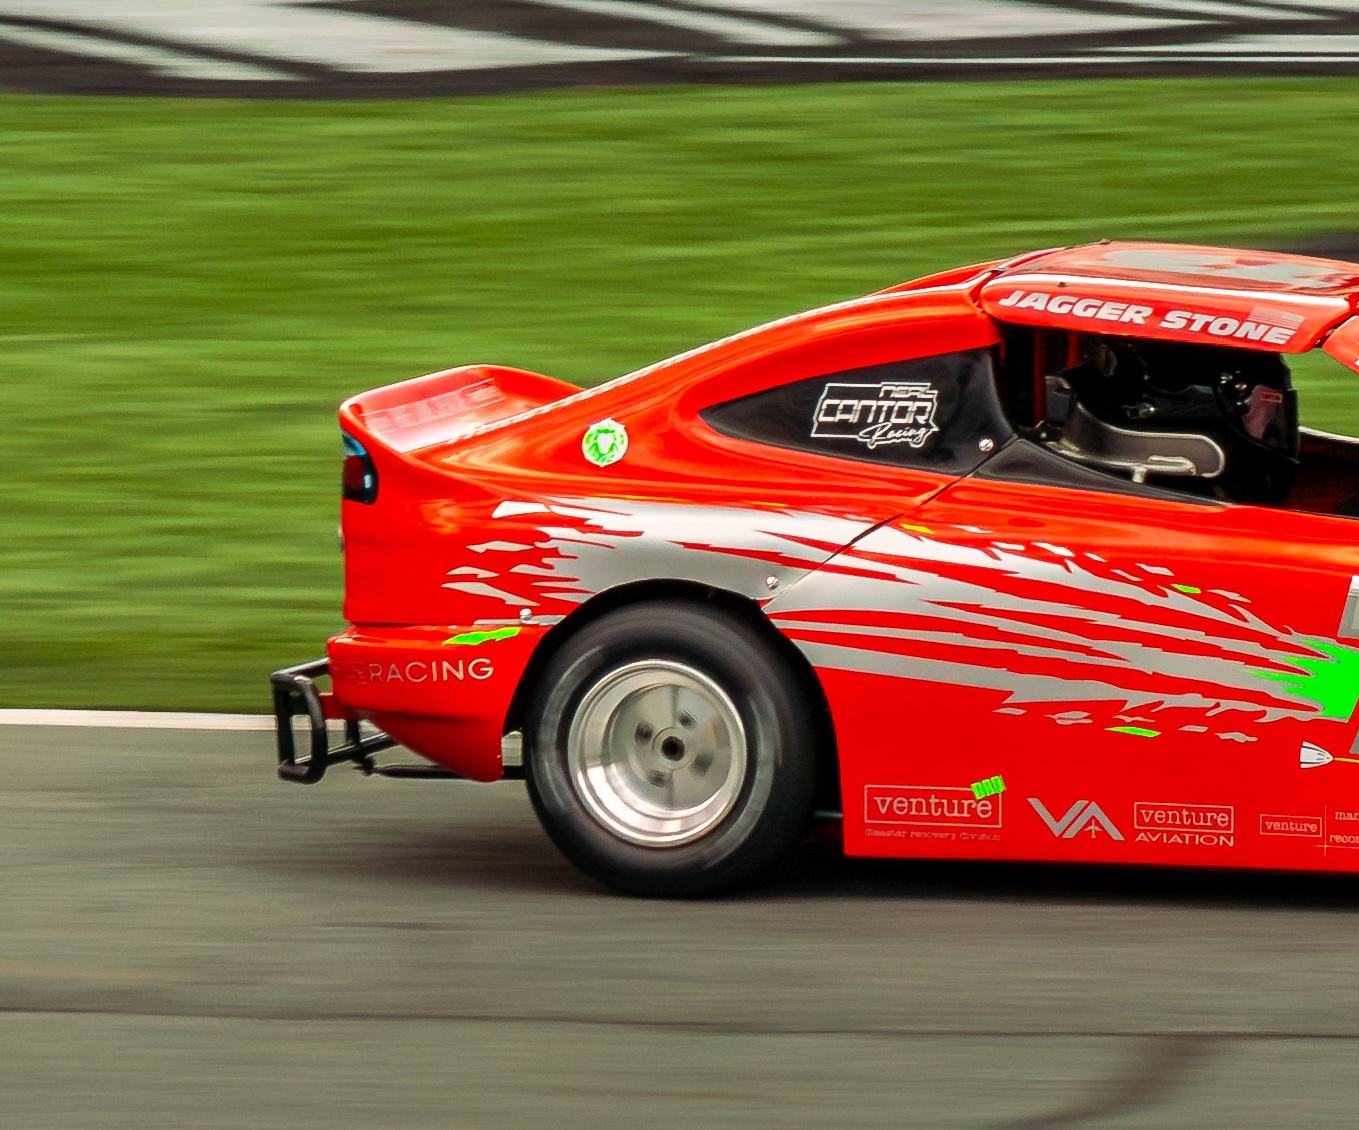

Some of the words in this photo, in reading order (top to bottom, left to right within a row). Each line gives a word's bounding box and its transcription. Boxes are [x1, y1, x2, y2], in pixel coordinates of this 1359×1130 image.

[999, 290, 1153, 325] JAGGER
[1160, 310, 1297, 345] STONE
[818, 399, 932, 424] CANTOR
[858, 422, 929, 446] Racing
[369, 658, 494, 683] RACING
[873, 794, 993, 818] venture
[1140, 808, 1230, 828] venture
[1265, 820, 1318, 832] venture
[1135, 832, 1235, 848] AVIATION
